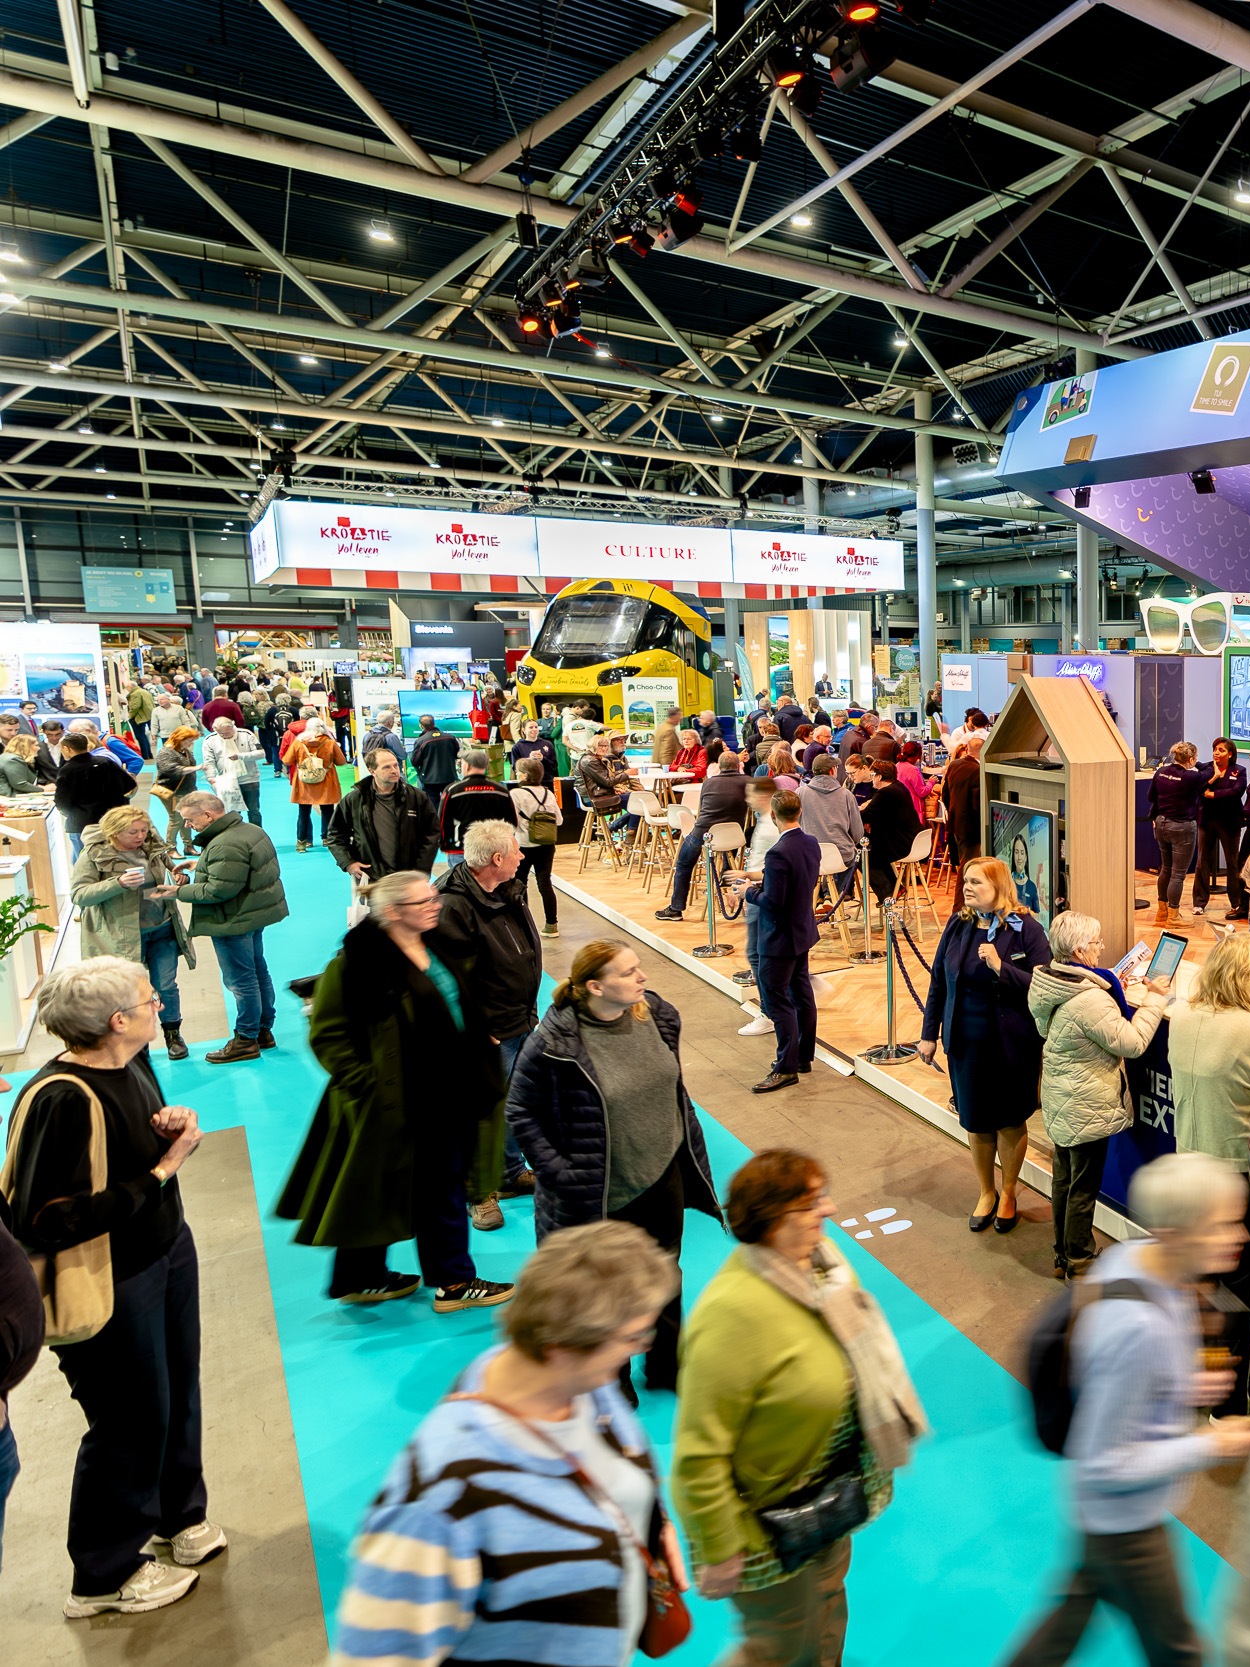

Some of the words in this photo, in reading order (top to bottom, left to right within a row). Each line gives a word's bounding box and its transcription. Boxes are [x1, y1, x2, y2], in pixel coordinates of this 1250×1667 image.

[1199, 397, 1210, 405] TIME
[1211, 398, 1217, 406] TO
[1217, 399, 1233, 407] SMILE
[320, 527, 392, 542] KROATIE
[436, 533, 500, 547] KROATIE
[355, 543, 379, 555] leven
[467, 549, 489, 560] leven
[605, 544, 697, 560] CULTURE
[761, 551, 807, 562] KROATIE
[836, 555, 879, 567] KROATIE
[415, 625, 453, 634] Slovenia
